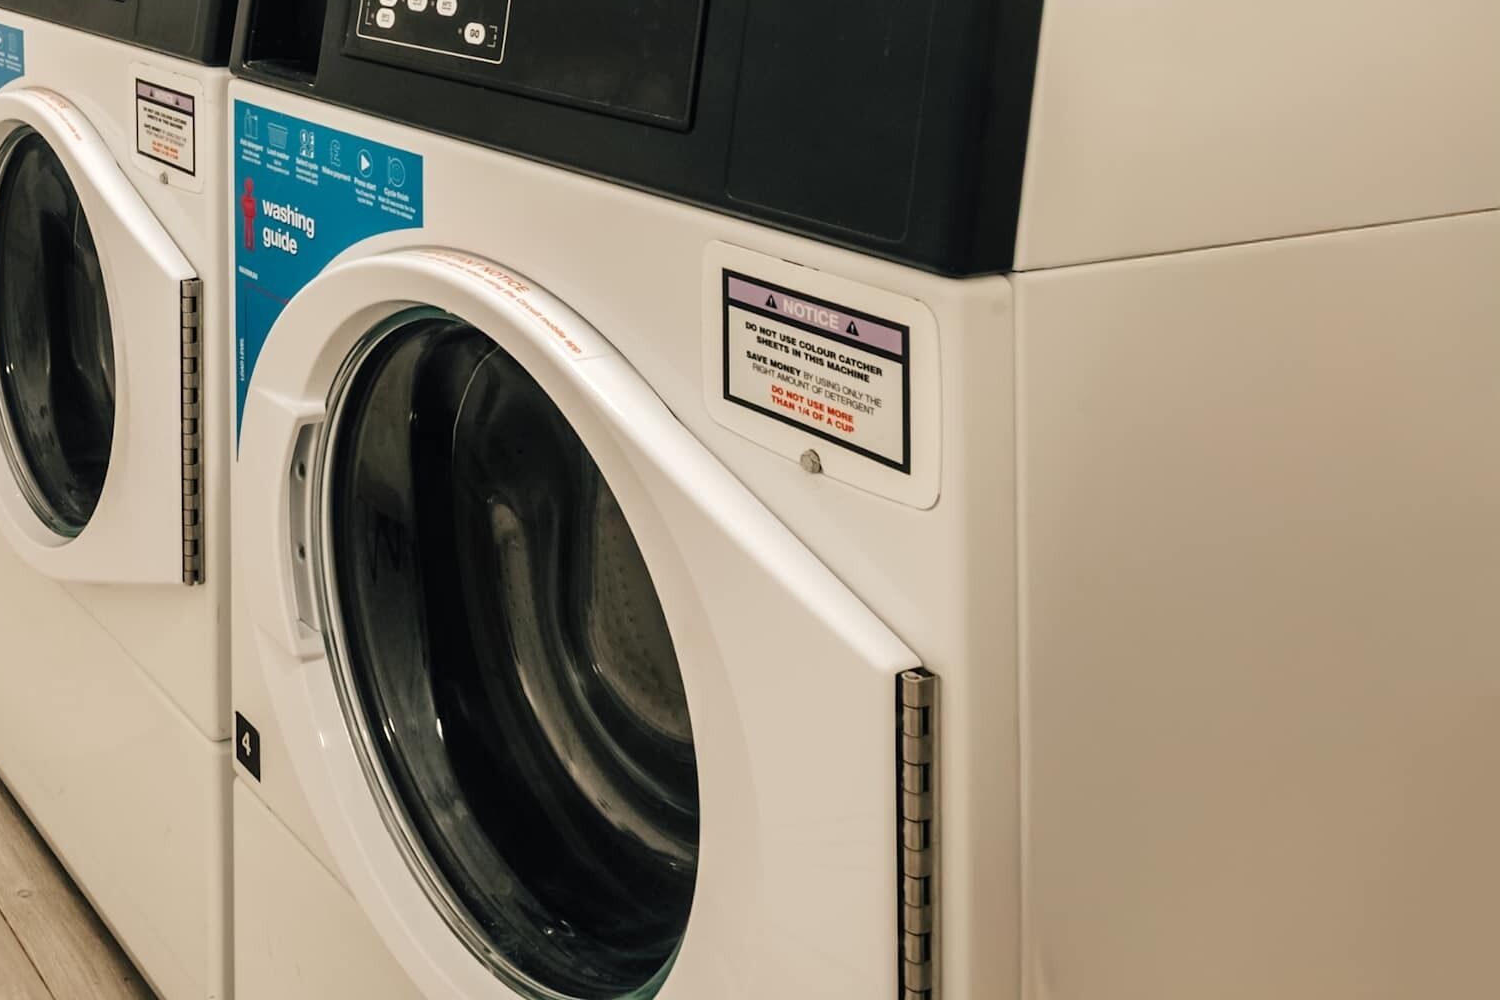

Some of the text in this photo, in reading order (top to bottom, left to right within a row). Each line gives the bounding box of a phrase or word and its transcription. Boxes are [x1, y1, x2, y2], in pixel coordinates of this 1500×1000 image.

[262, 199, 314, 239] washing
[263, 227, 298, 255] guide
[783, 298, 839, 330] NOTICE
[745, 321, 883, 377] DO NOT USE COLOUR CATCHER
[756, 336, 870, 383] SHEETS IN THIS MACHINE
[746, 350, 882, 408] SAVE MONEY BY USING ONLY THE
[752, 362, 875, 415] RIGHT AMOUNT OF DETERGENT
[771, 384, 854, 424] DO NOT USE MORE
[771, 395, 854, 433] THAN 1/4 OF A CUP
[242, 731, 252, 756] 4
